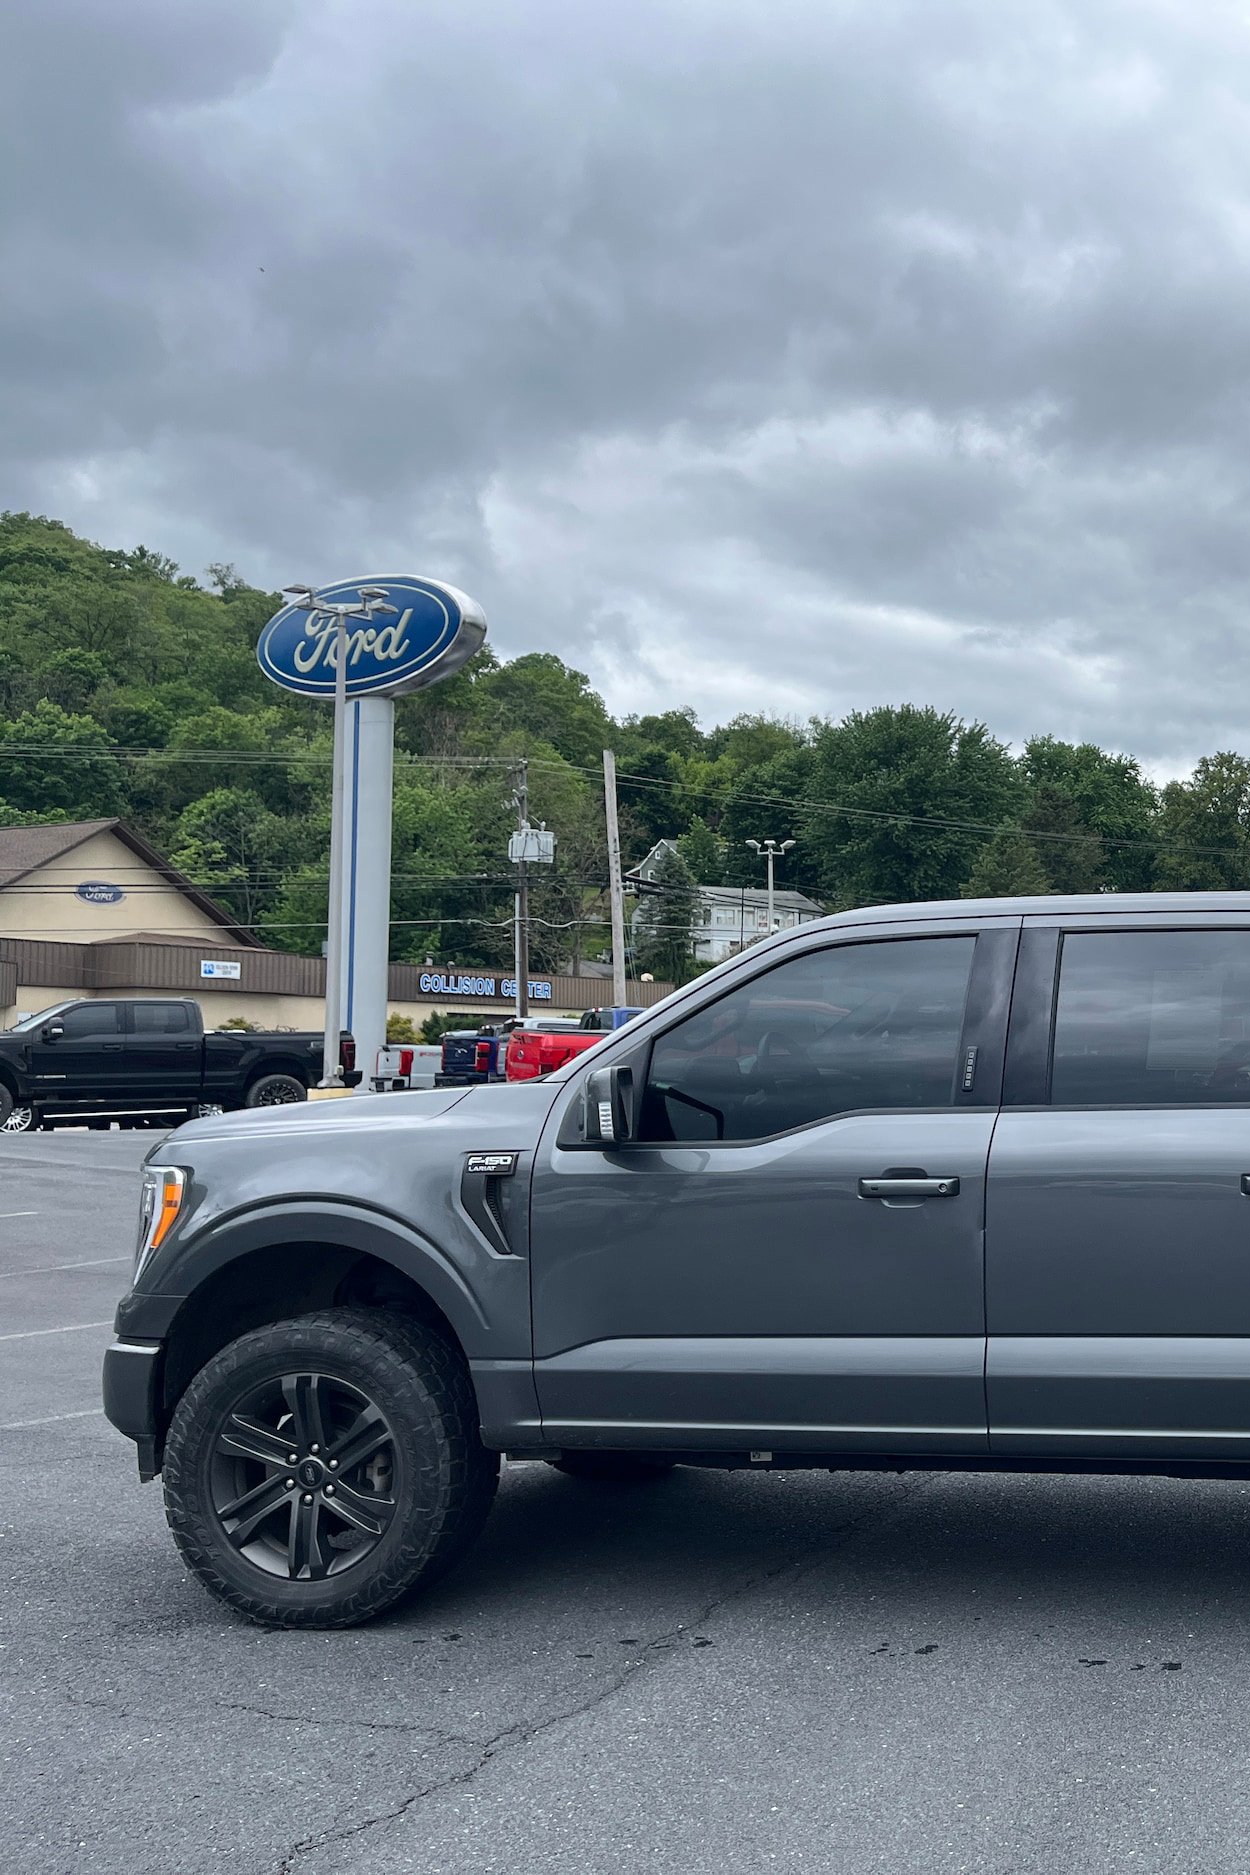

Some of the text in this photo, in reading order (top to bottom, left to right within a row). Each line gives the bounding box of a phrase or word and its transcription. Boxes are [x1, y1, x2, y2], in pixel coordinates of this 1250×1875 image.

[294, 606, 413, 673] Ford
[420, 973, 552, 999] COLLISION CETER
[468, 1156, 513, 1166] F-150
